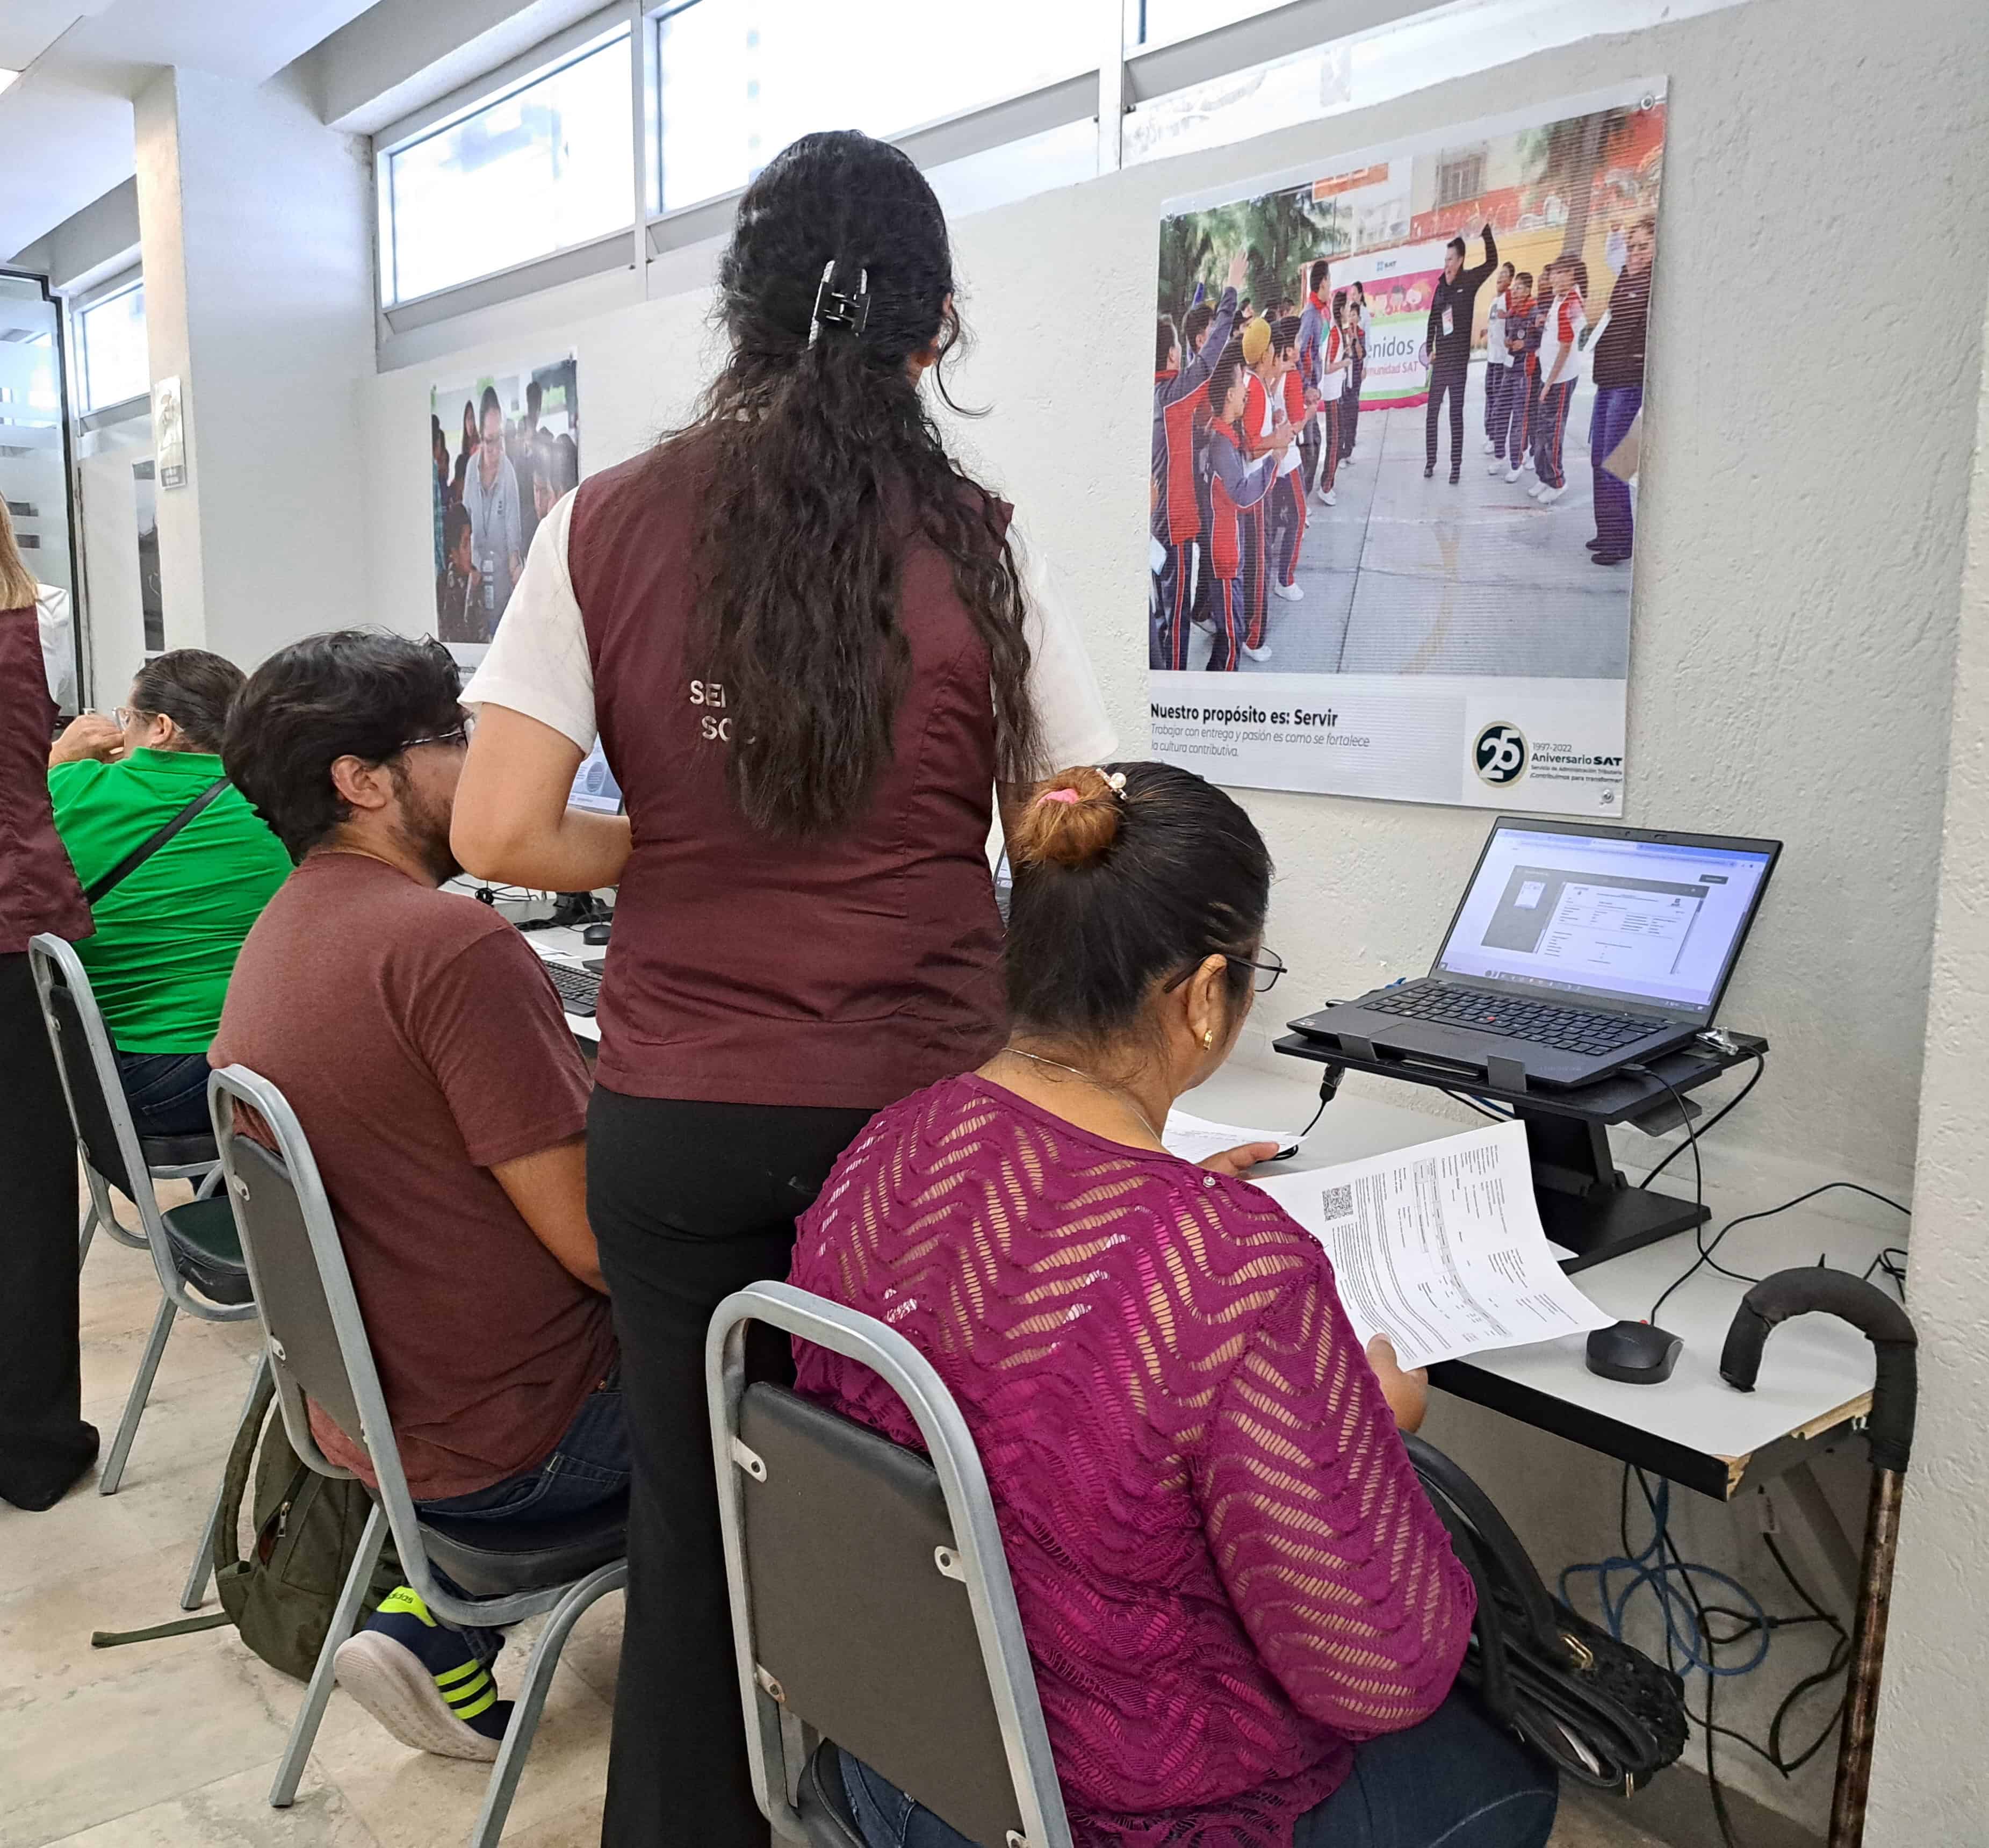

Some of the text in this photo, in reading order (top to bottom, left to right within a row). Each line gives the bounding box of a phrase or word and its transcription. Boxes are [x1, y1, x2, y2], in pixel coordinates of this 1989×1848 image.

[1402, 361, 1418, 373] SAT
[1151, 703, 1338, 727] Nuestro propósito es: Servir
[1151, 723, 1370, 747] Trabajar con entrega y pasión es como se fortalece
[1151, 740, 1239, 757] la cultura contributiva.
[1478, 729, 1521, 779] 25
[1532, 742, 1573, 752] 1997-2022
[1531, 752, 1623, 766] Aniversario SAT
